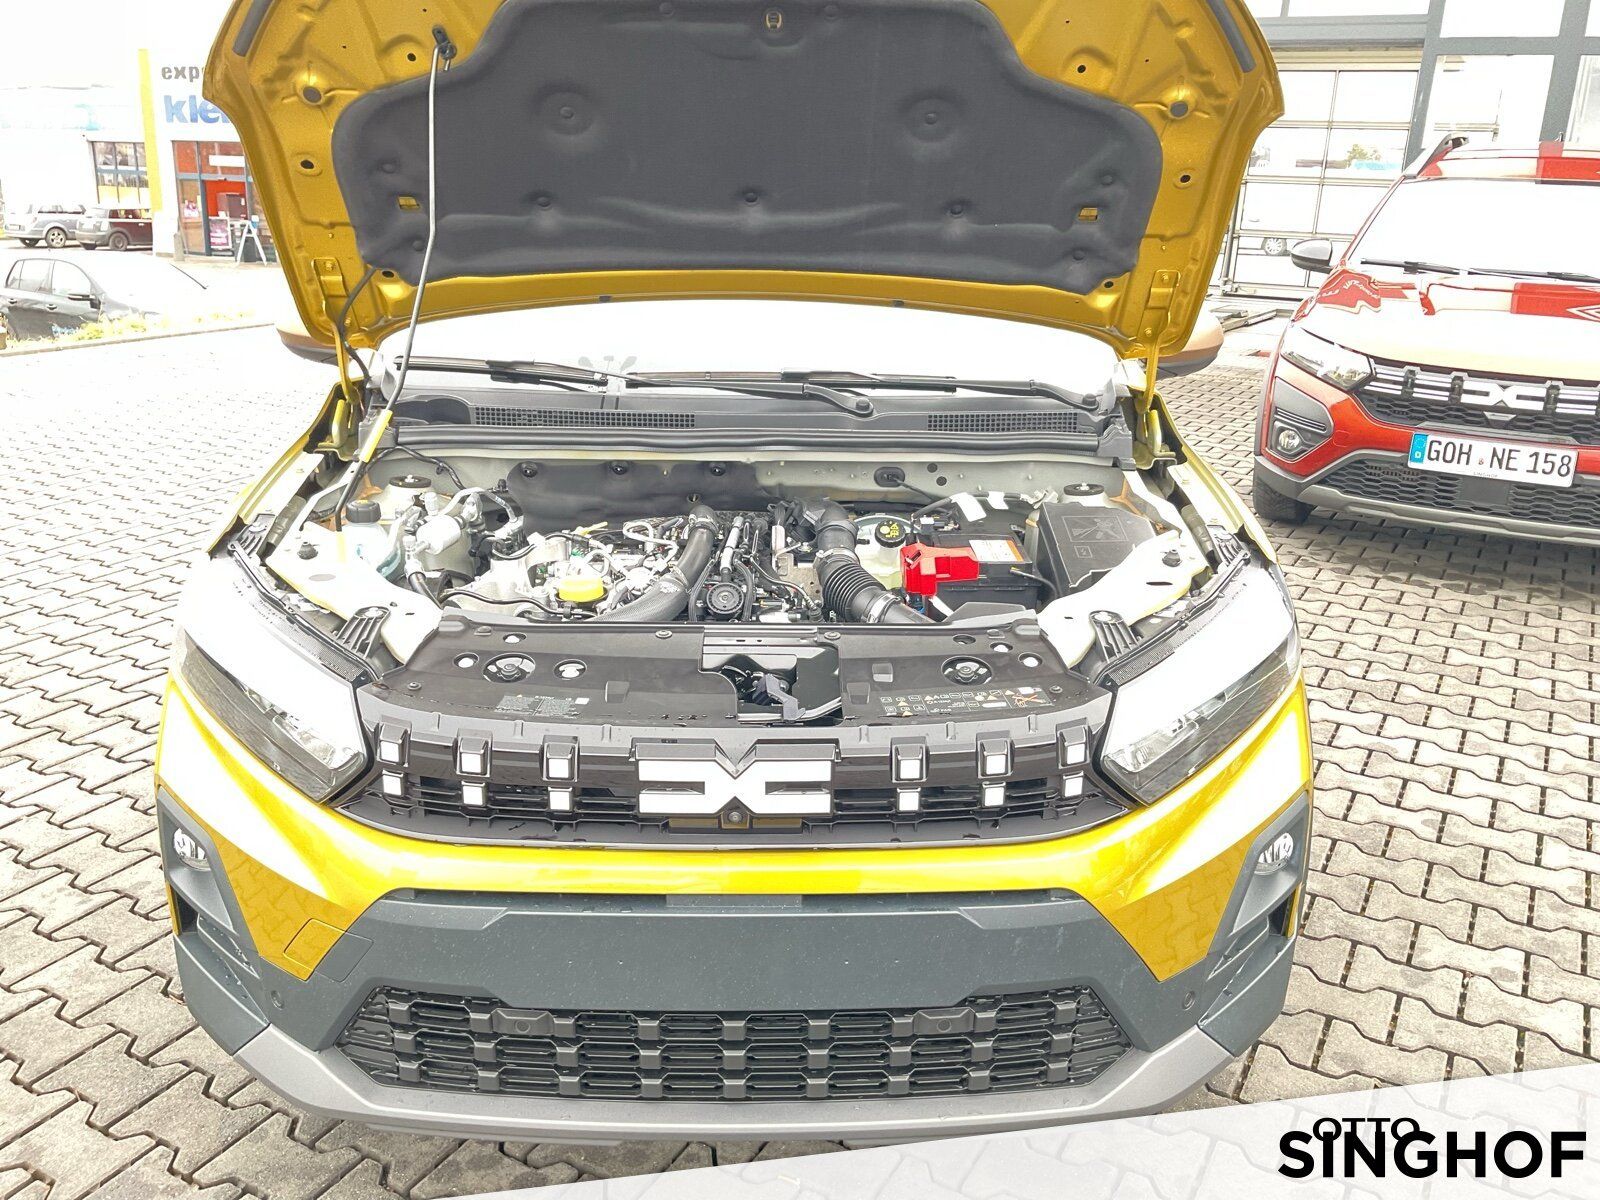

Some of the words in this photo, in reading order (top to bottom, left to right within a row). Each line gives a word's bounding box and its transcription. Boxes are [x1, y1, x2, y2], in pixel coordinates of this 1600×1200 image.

[1427, 439, 1473, 466] GOH
[1490, 447, 1521, 471] NE
[1526, 451, 1573, 478] 158
